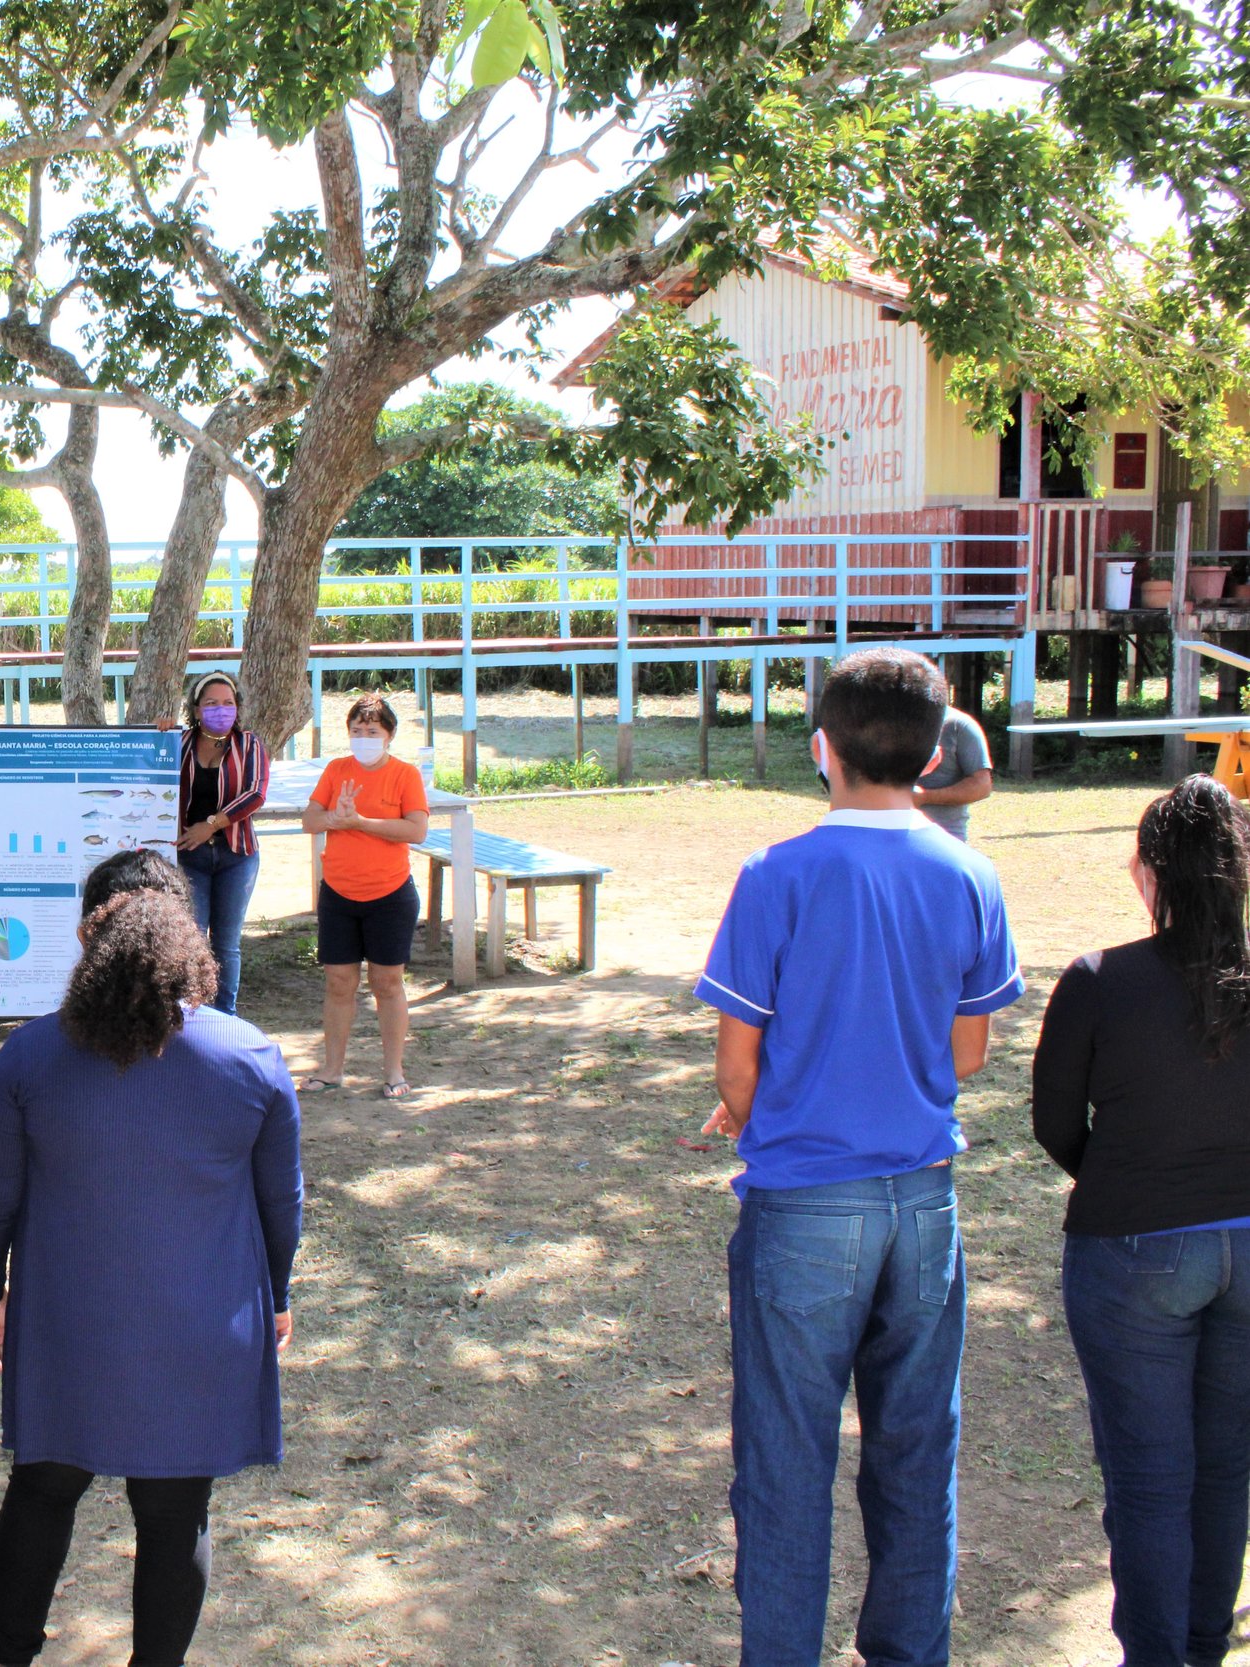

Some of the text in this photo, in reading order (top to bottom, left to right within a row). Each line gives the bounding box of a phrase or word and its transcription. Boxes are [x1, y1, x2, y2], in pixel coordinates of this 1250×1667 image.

[781, 336, 891, 383] FUNDAMENTAL
[801, 375, 904, 433] Maria
[839, 450, 903, 487] SEMED
[83, 742, 121, 751] CORAÇÃO
